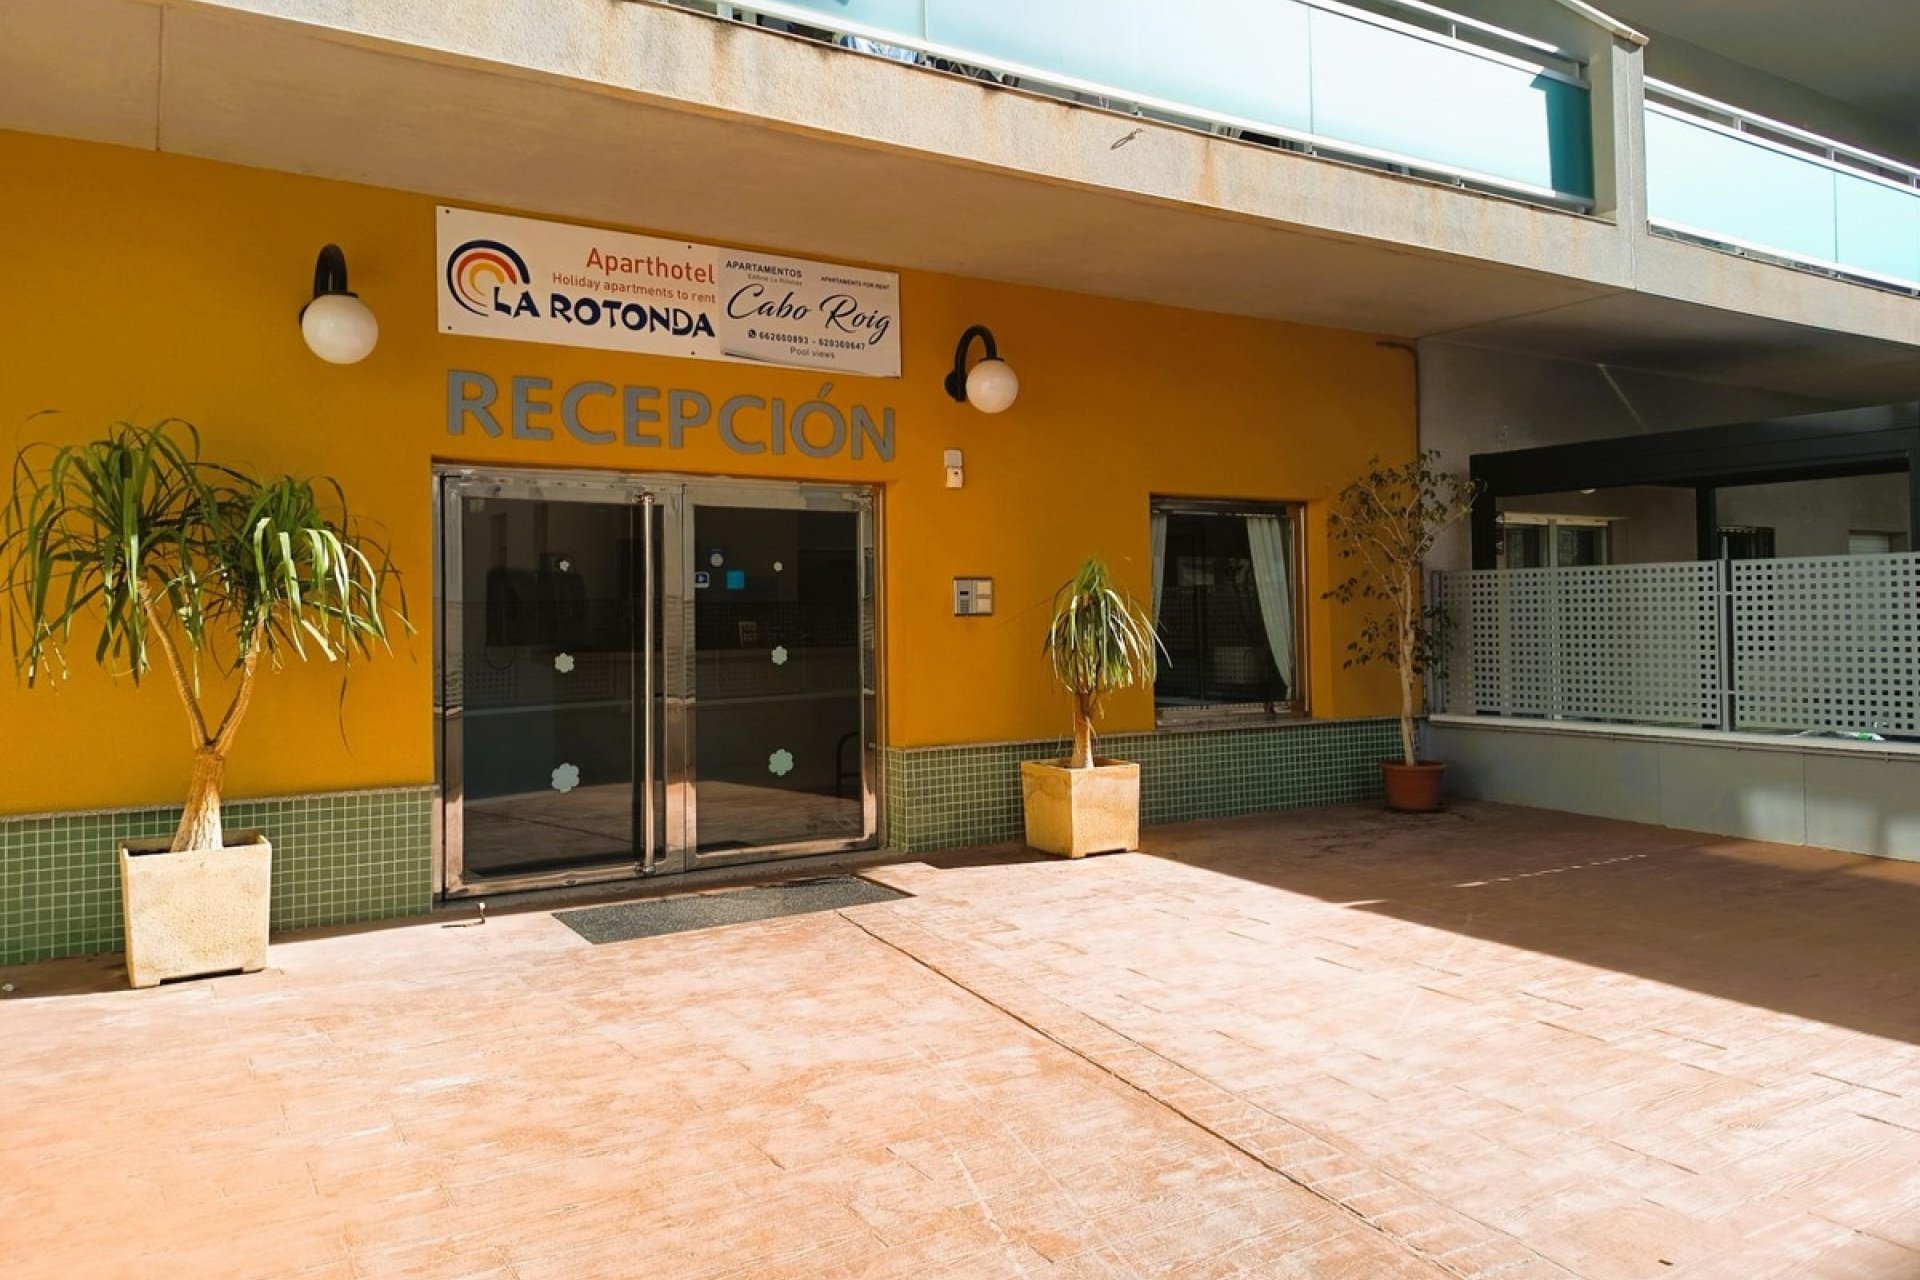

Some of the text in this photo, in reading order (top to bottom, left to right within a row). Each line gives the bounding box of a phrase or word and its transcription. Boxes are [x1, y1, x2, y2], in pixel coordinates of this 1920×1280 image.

[587, 247, 716, 285] Aparthotel
[726, 260, 802, 278] APARTAMENTOS
[552, 272, 716, 304] Holiday apartments to rent
[494, 286, 716, 338] LA ROTONDA
[727, 283, 892, 346] Cabo Roig
[790, 345, 836, 360] Pool views
[446, 369, 896, 463] RECEPCIÓN
